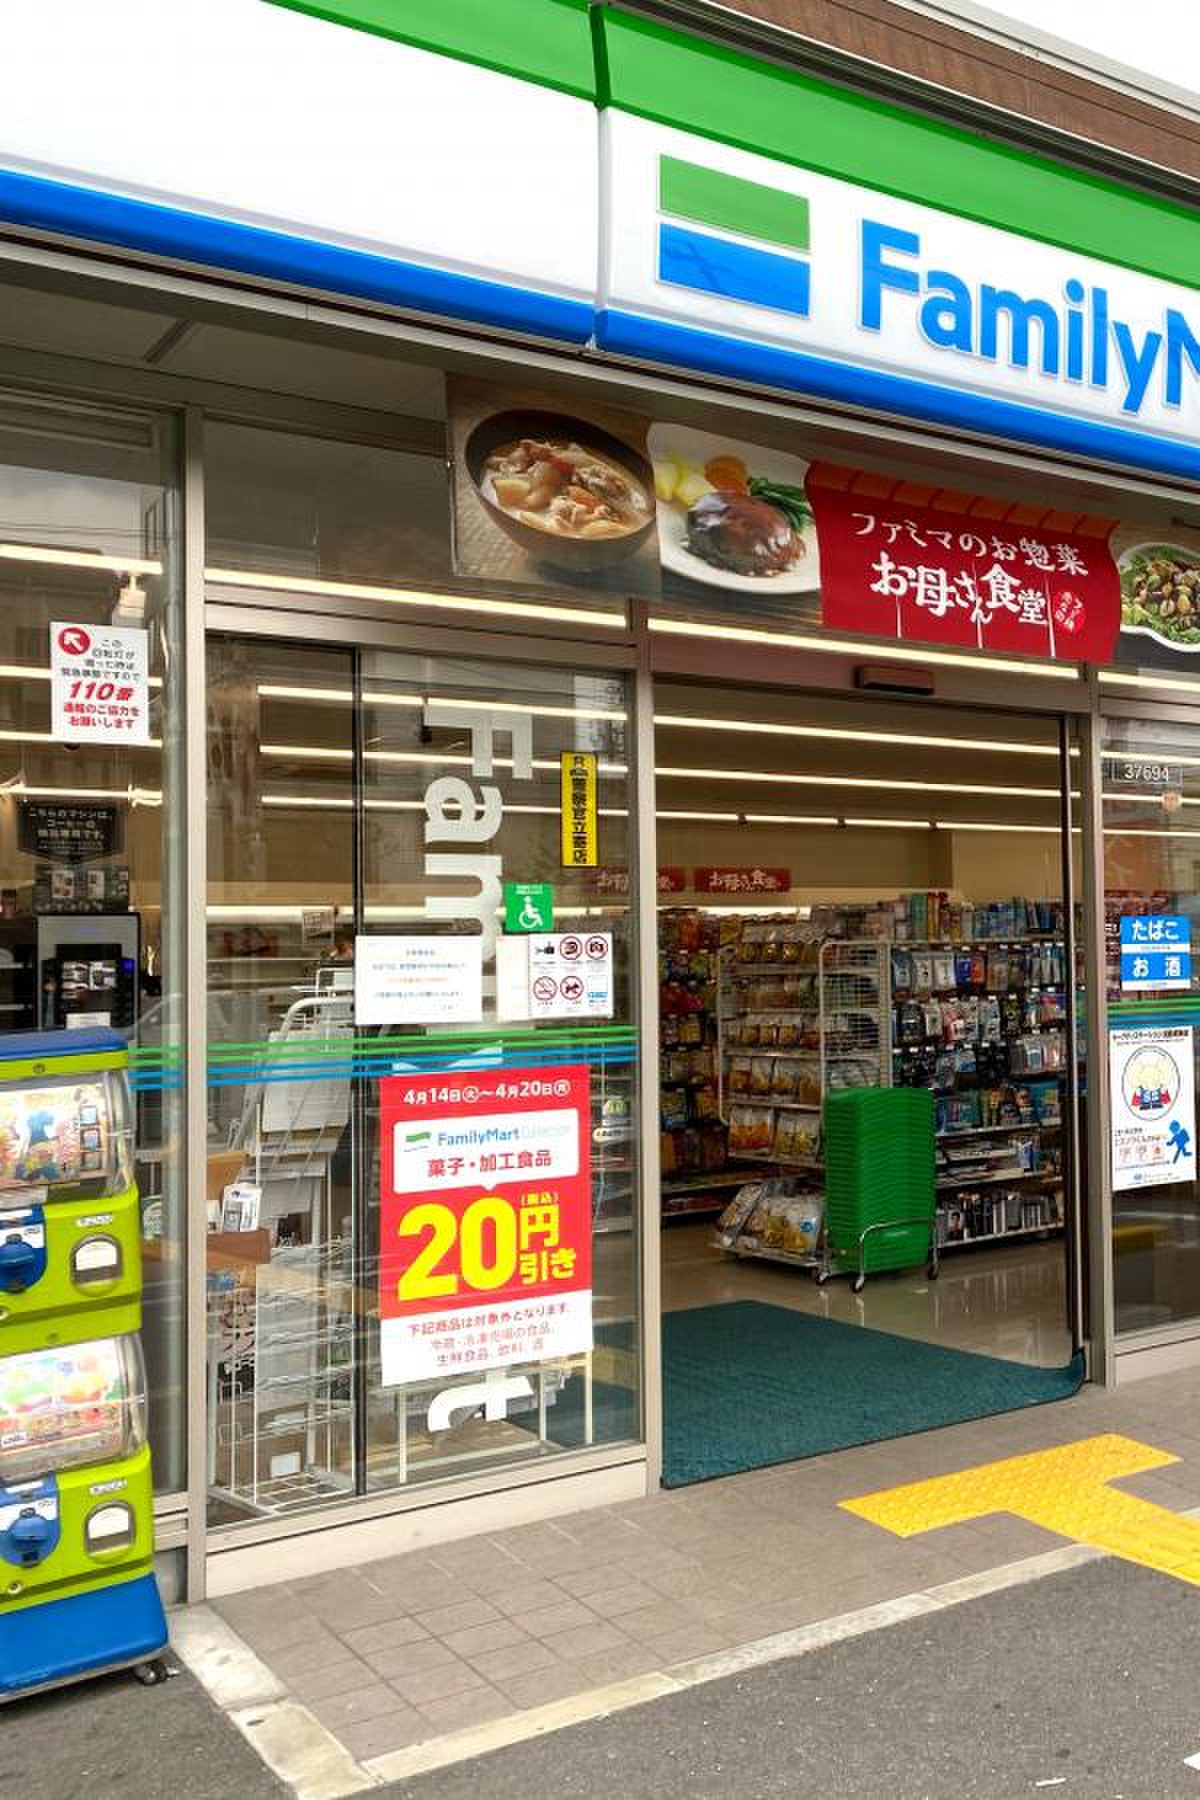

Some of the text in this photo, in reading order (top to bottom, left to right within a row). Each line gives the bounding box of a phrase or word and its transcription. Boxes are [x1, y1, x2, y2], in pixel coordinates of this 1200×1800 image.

[851, 512, 1089, 576] ファミマのお惣菜
[870, 551, 1049, 625] お母さん食堂
[1131, 919, 1179, 940] たばこ
[437, 1126, 520, 1147] FamilyMart
[427, 1149, 553, 1177] 菓子・加工食品
[398, 1196, 517, 1301] 20
